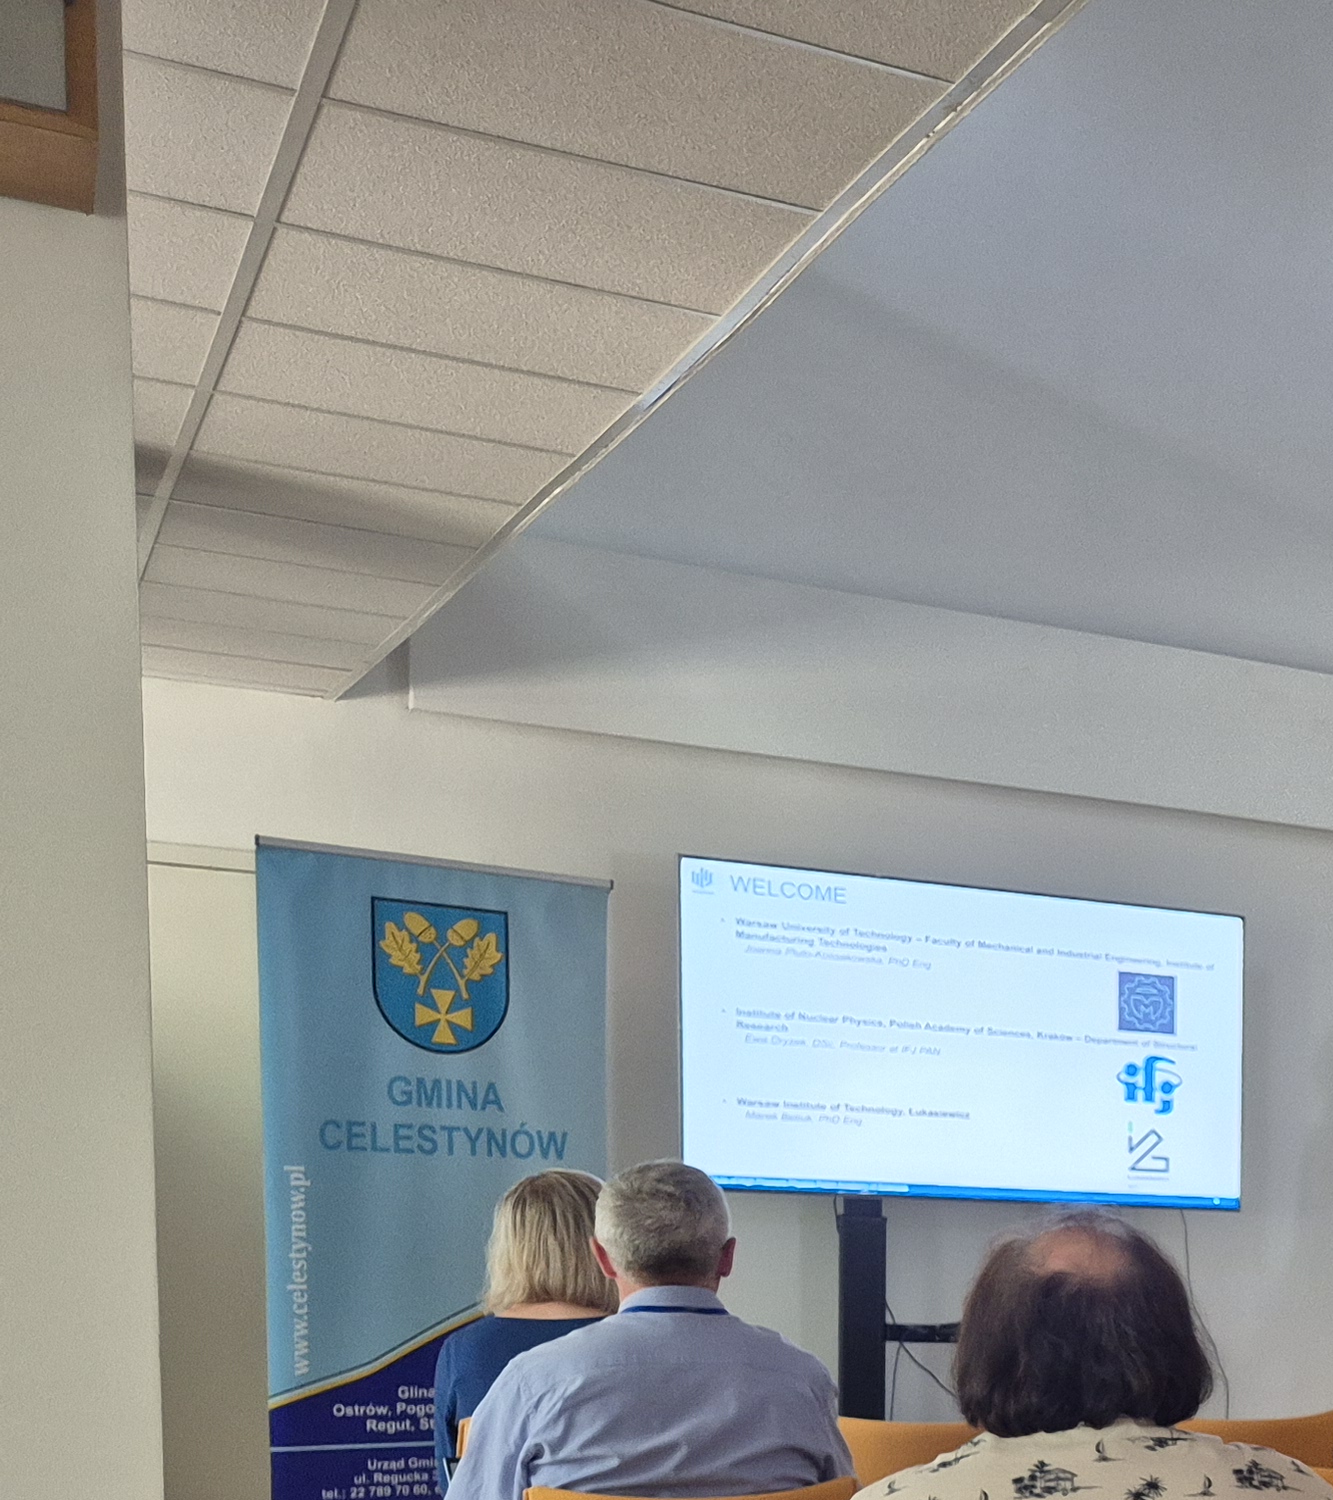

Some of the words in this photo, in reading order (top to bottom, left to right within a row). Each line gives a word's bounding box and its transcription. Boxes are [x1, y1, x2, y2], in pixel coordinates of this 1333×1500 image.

[730, 874, 847, 904] WELCOME
[735, 916, 778, 930] Warsaw
[781, 922, 835, 937] University
[839, 926, 851, 936] of
[853, 928, 912, 944] Technology
[924, 935, 962, 949] Faculty
[965, 938, 975, 949] of
[977, 940, 1034, 954] Mechanical
[1036, 945, 1055, 956] and
[735, 929, 815, 947] Manufacturing
[818, 936, 888, 953] Technologies
[735, 1007, 782, 1021] Institute
[784, 1011, 796, 1021] of
[798, 1012, 839, 1024] Nuclear
[889, 1018, 922, 1031] Polish
[924, 1021, 971, 1036] Academy
[974, 1025, 985, 1036] of
[735, 1020, 789, 1033] Research
[387, 1075, 505, 1112] GMINA
[736, 1097, 780, 1109] Warsaw
[783, 1099, 827, 1111] Institute
[829, 1102, 840, 1112] of
[319, 1118, 569, 1161] CELESTYNÓW
[284, 1165, 312, 1377] www.celestynow.pl
[332, 1401, 392, 1418] Ostrów,
[396, 1401, 436, 1418] Pogo
[366, 1418, 415, 1435] Regut,
[367, 1457, 405, 1472] Urząd
[408, 1456, 437, 1469] Gmi
[354, 1472, 370, 1485] ul.
[373, 1471, 429, 1486] Regucka
